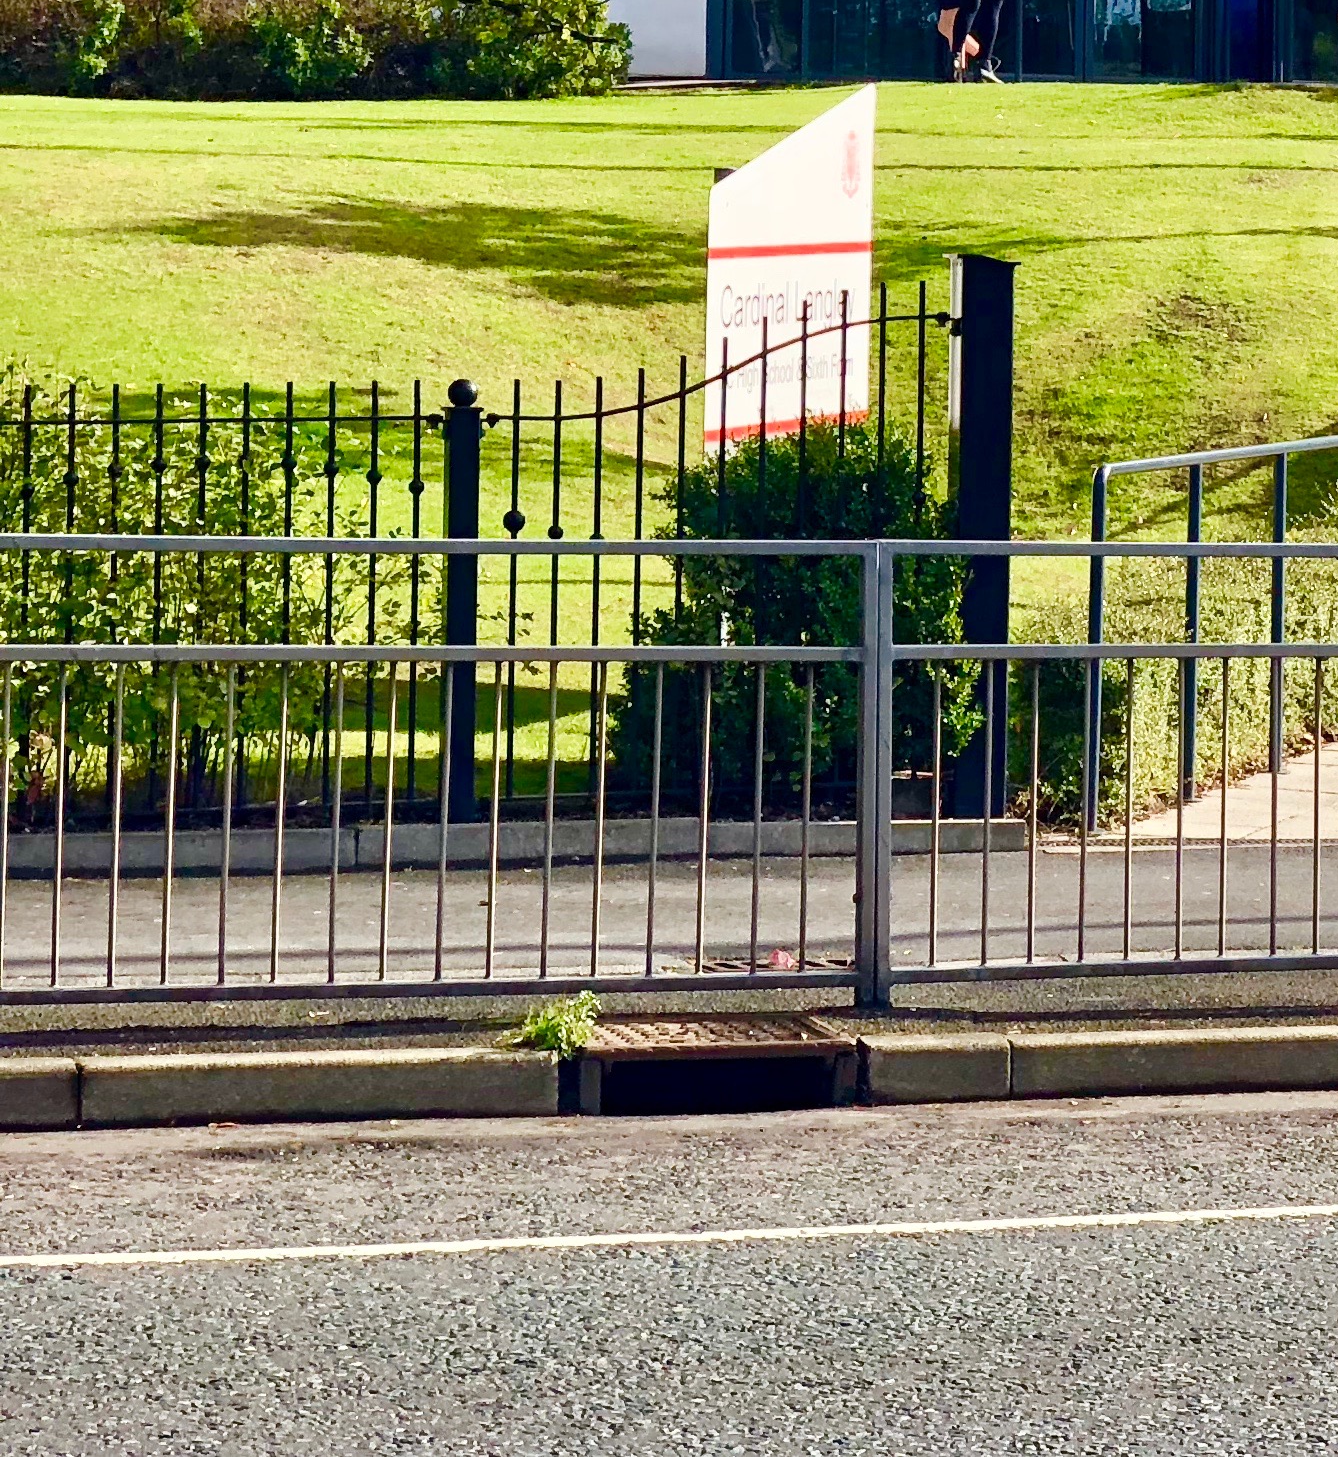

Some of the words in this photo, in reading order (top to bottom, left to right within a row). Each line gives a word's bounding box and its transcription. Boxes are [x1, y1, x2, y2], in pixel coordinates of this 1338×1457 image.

[721, 281, 789, 328] Cardinal
[736, 361, 759, 394] High
[762, 357, 794, 385] chool
